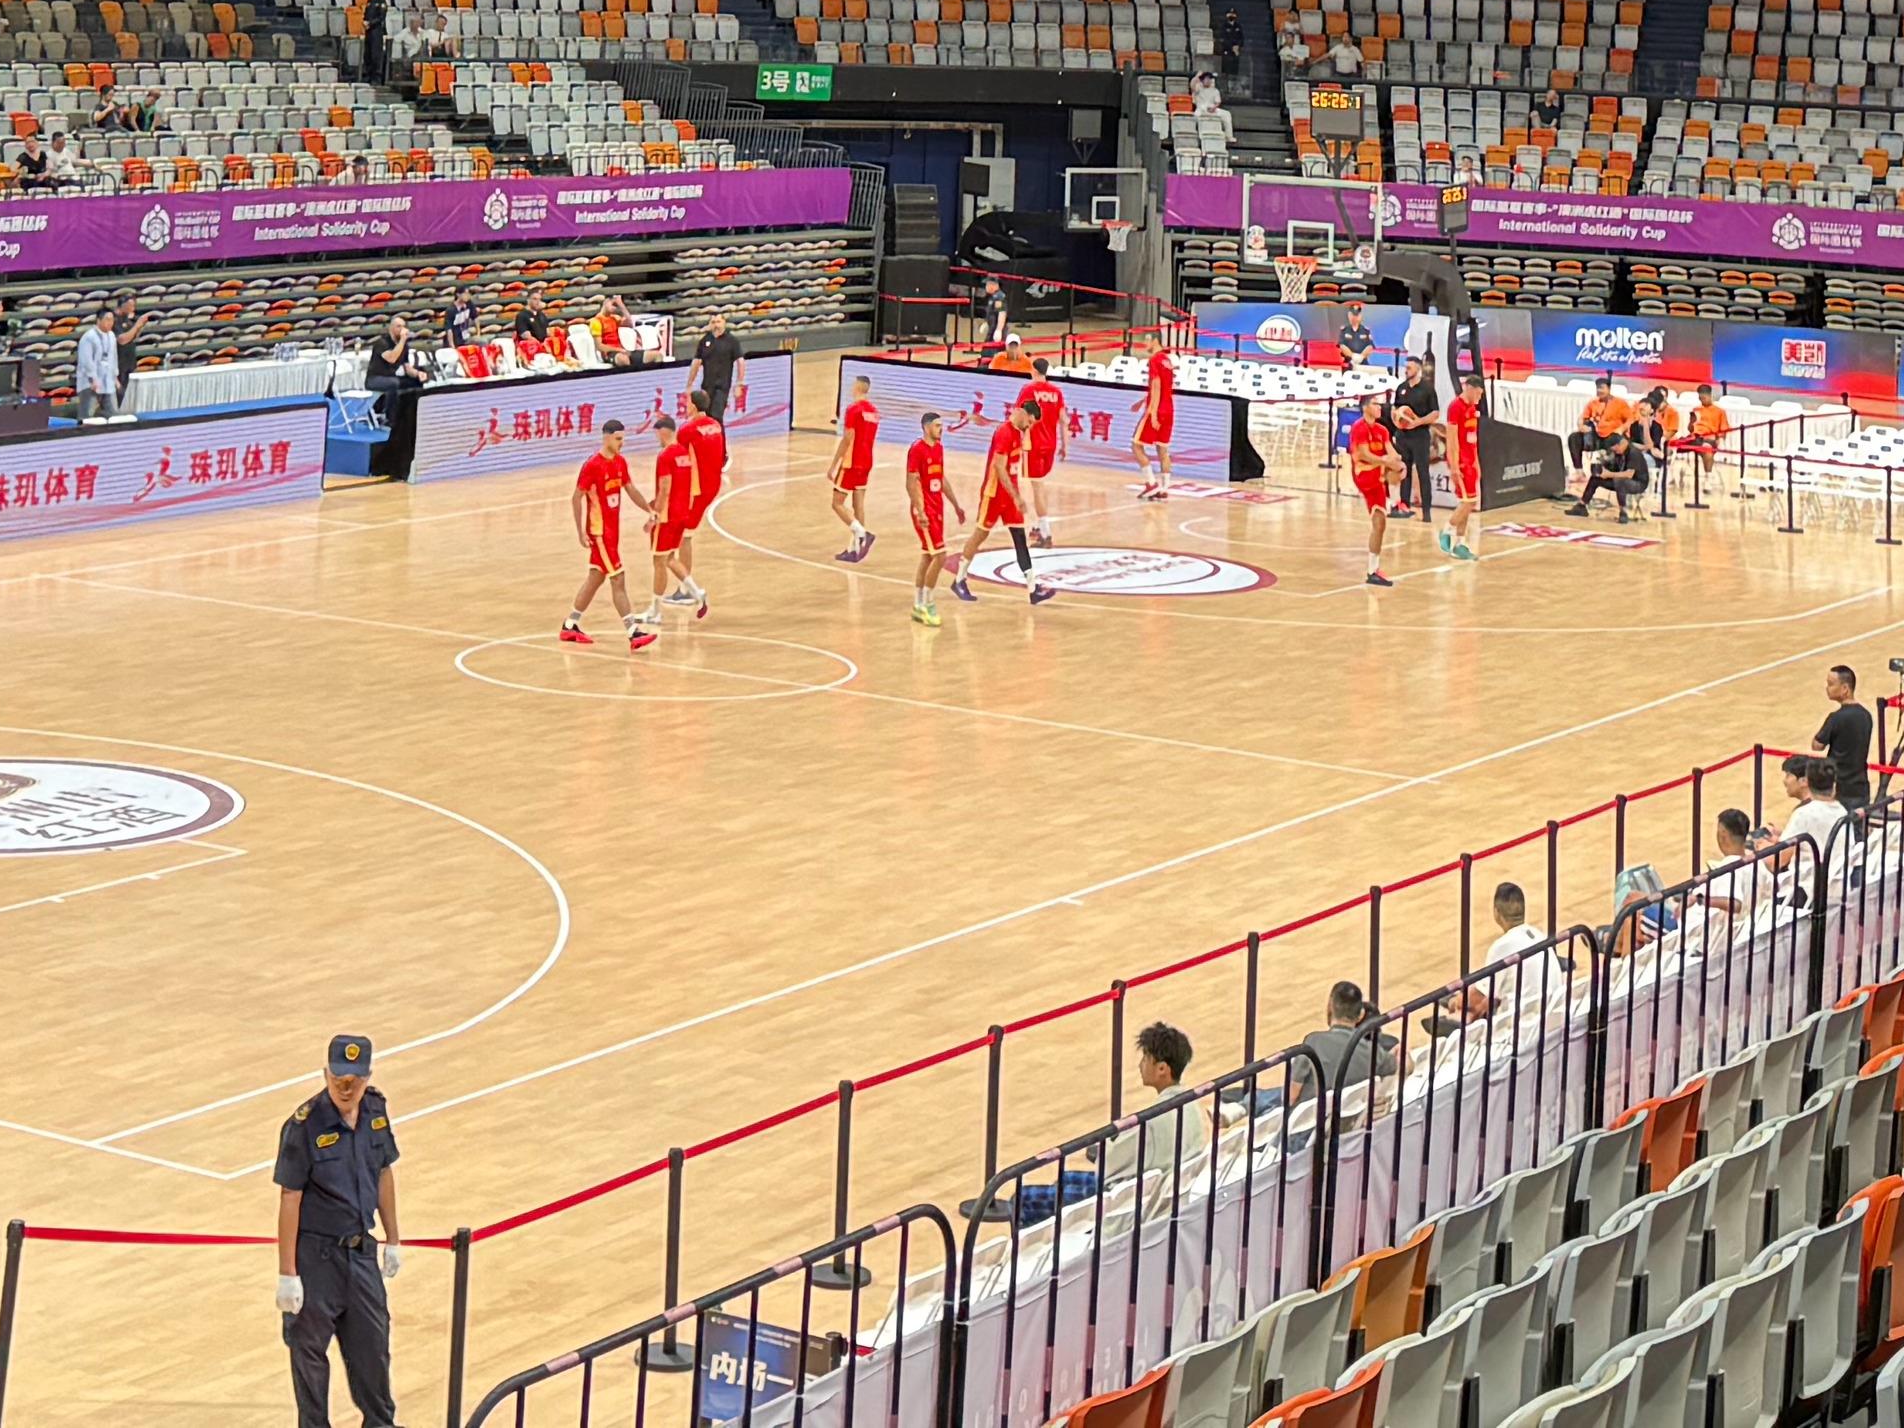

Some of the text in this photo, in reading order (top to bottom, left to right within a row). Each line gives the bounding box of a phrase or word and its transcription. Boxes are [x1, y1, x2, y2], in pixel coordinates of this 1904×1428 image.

[761, 70, 790, 93] 3号
[254, 220, 390, 241] International Solidarity Cup
[1499, 219, 1666, 242] International Solidarity Cup
[1575, 327, 1662, 352] molten
[513, 403, 595, 441] 珠玑体育
[188, 440, 291, 485] 珠玑体育
